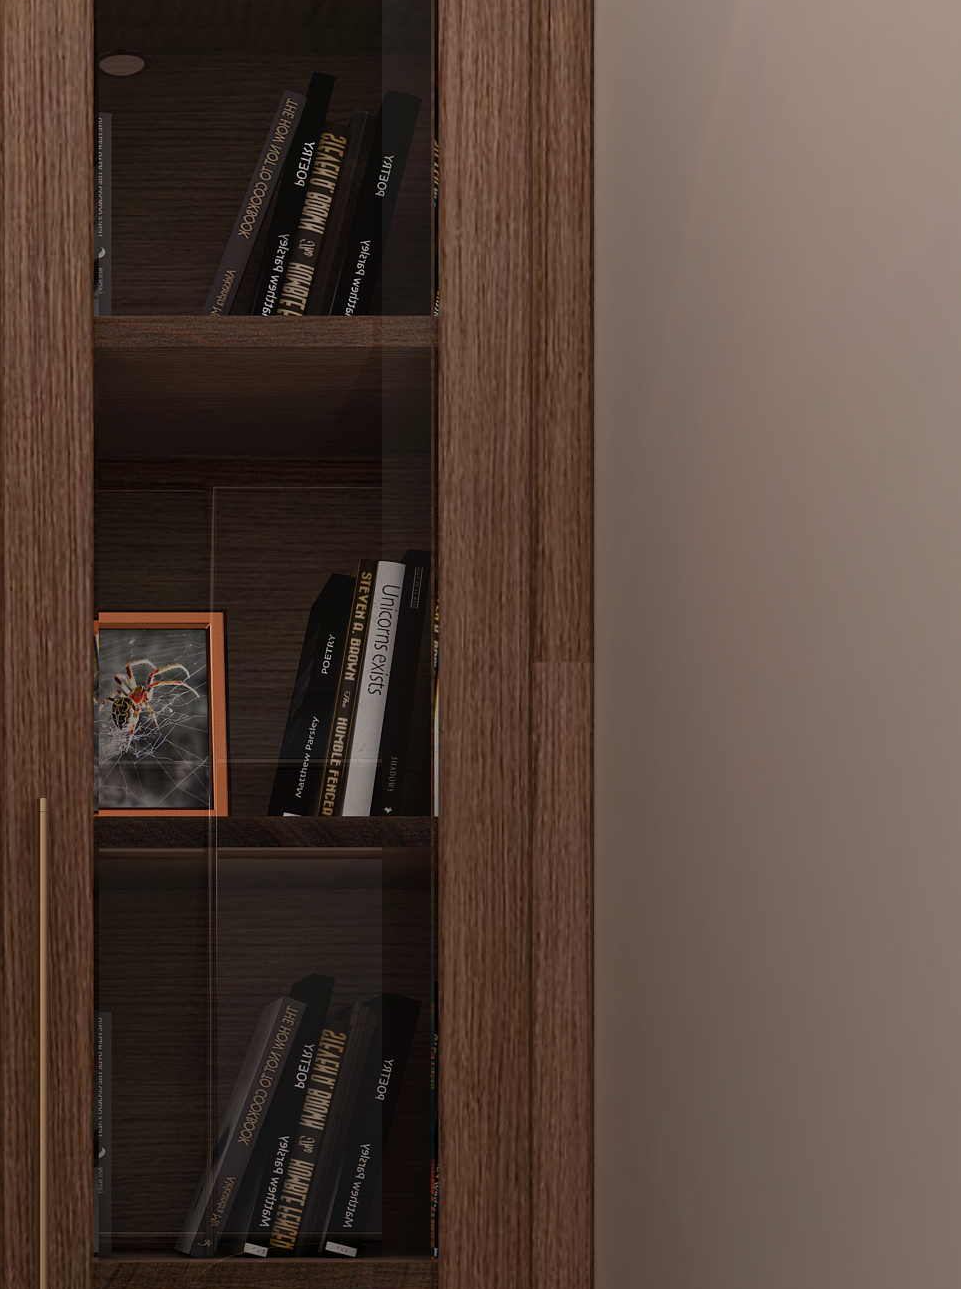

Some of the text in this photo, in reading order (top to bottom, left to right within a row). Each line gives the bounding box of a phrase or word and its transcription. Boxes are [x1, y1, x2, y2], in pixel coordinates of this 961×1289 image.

[322, 633, 336, 675] POETRY
[346, 571, 372, 681] STEVEN A. BROWN
[368, 585, 400, 695] Unicorns exists
[296, 716, 319, 799] Matthew Parsley
[323, 716, 348, 816] HUMBLE FENCER
[388, 757, 398, 792] SHADOWS
